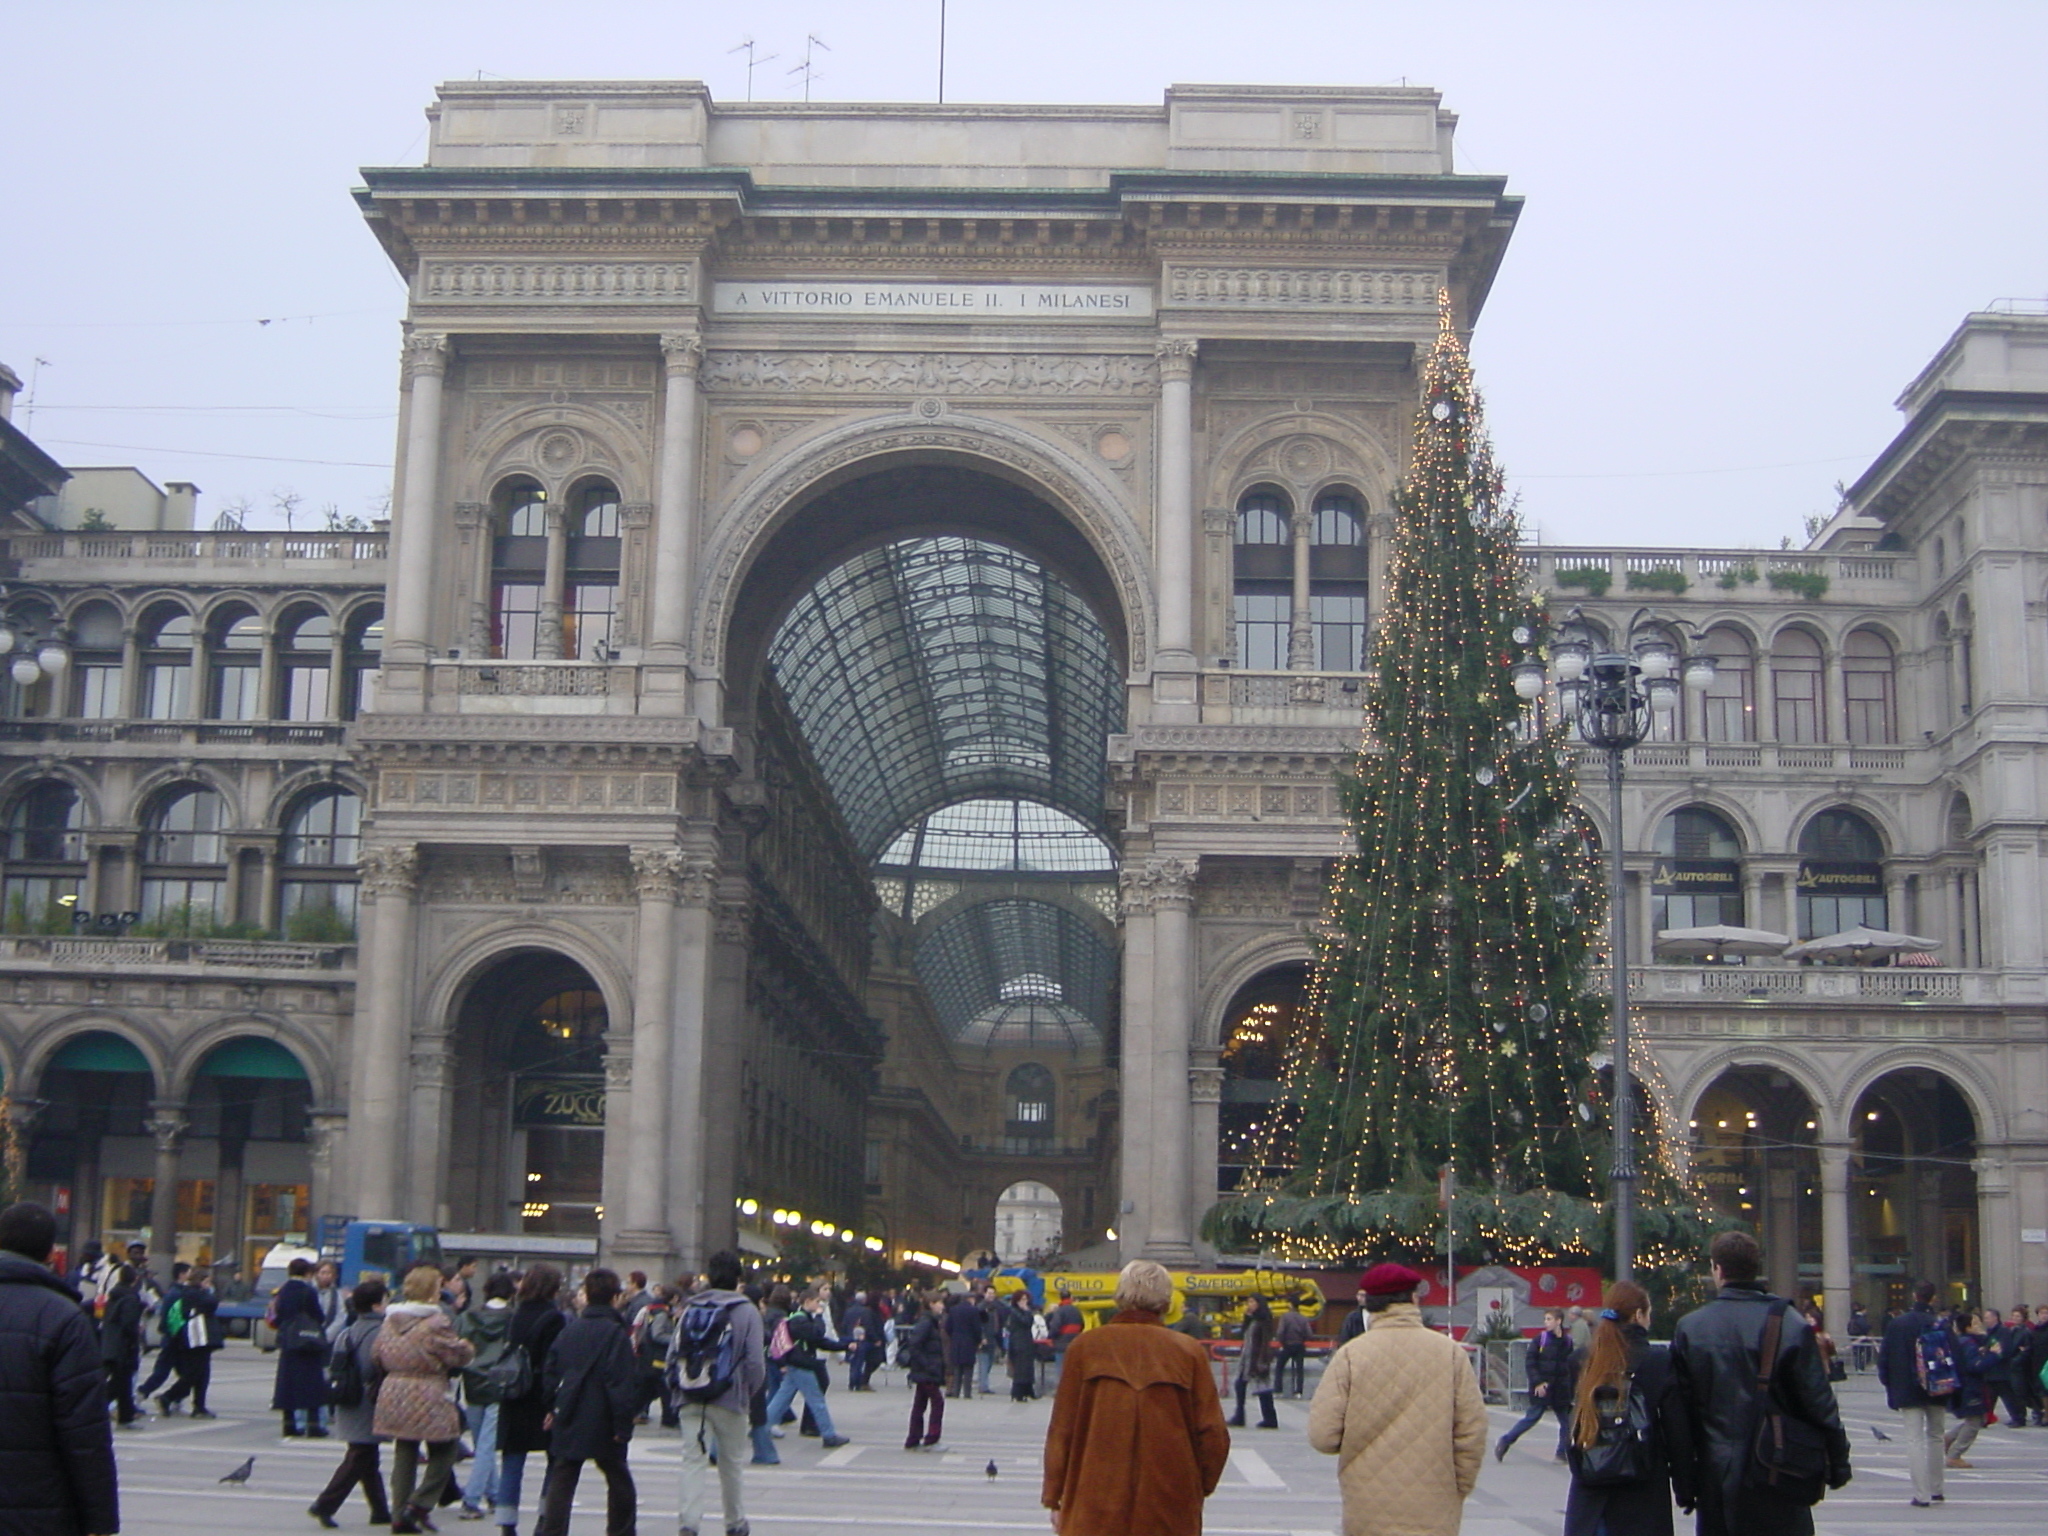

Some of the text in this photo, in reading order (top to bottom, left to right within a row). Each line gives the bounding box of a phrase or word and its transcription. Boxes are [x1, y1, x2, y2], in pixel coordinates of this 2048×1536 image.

[736, 291, 749, 305] A
[761, 291, 852, 306] VITTORIO
[864, 292, 974, 307] EMANUELE
[1037, 294, 1130, 309] MILANESI
[1675, 872, 1734, 881] AUTOGRILL
[1818, 874, 1877, 883] AUTOGRILL
